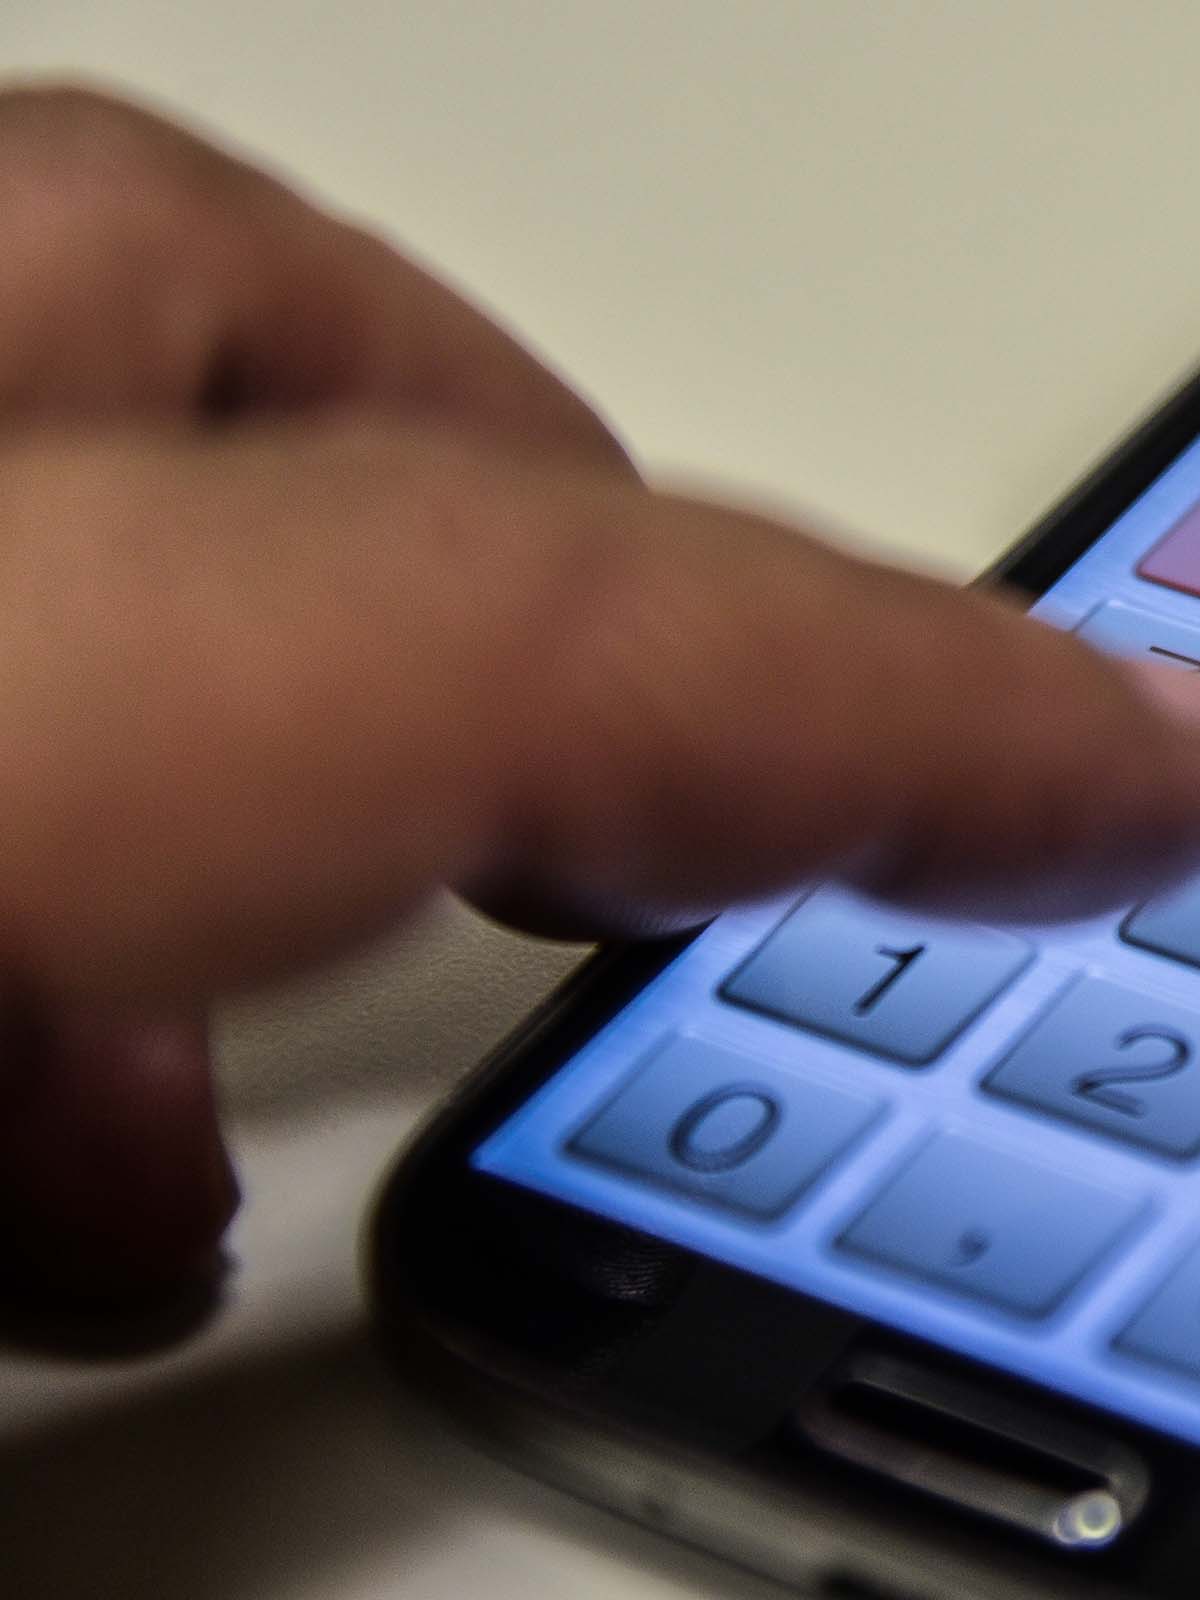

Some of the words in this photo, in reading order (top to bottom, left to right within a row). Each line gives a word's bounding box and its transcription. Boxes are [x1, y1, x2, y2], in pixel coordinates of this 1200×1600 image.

[853, 941, 927, 1018] 1
[1072, 1023, 1193, 1117] 2
[667, 1081, 782, 1176] 0
